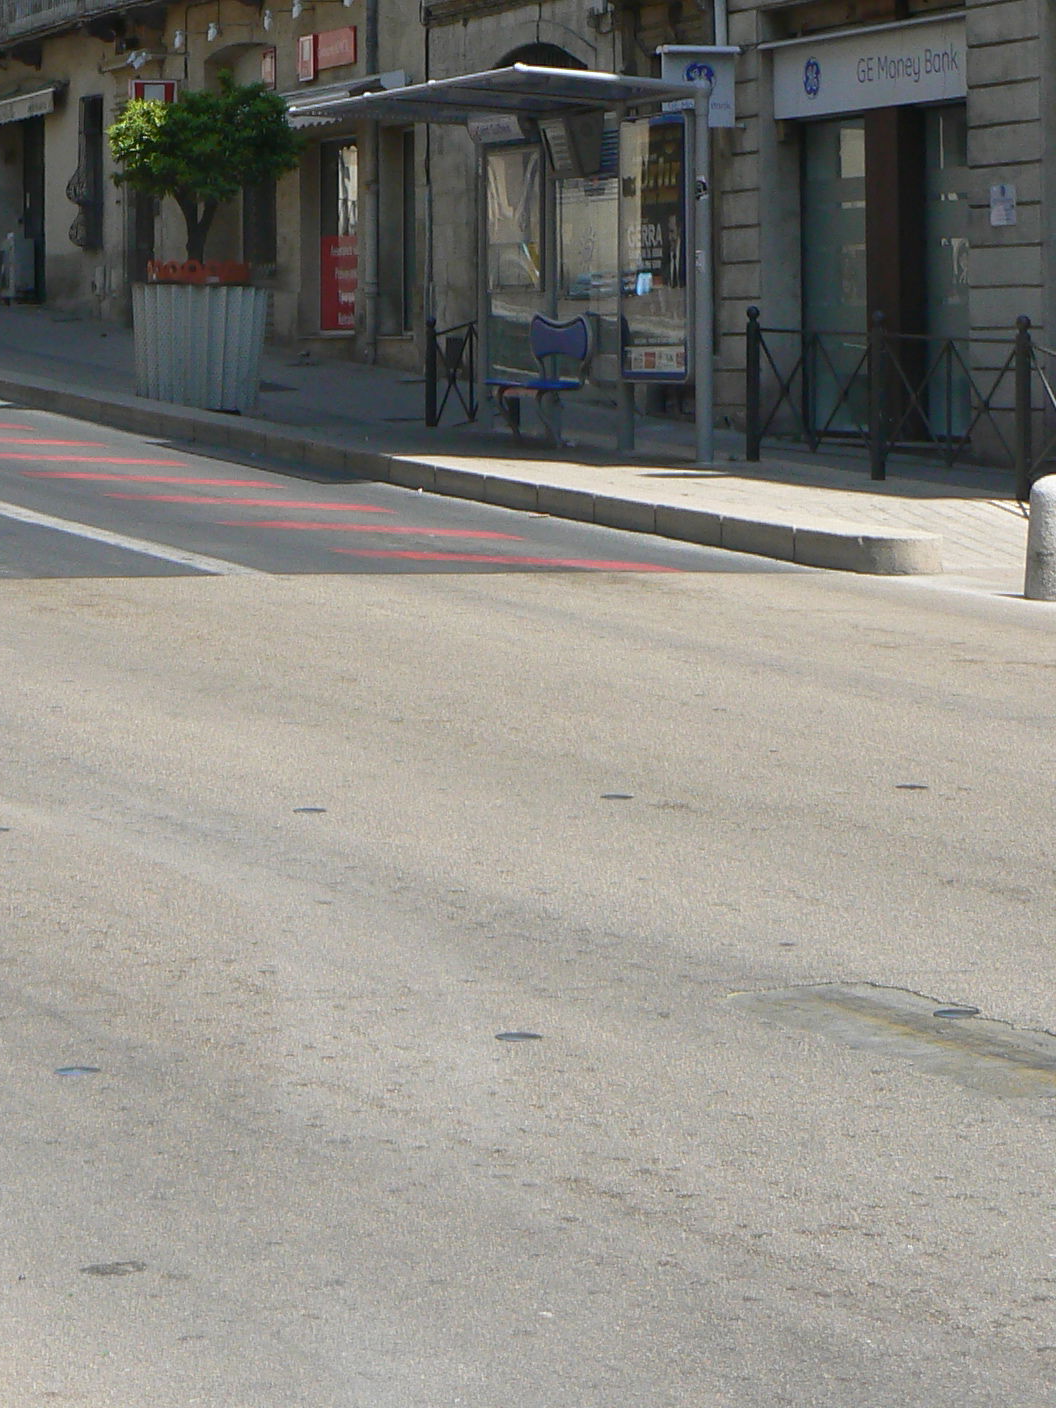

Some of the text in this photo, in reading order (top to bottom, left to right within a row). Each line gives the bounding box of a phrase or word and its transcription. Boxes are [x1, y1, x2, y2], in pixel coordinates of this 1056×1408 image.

[856, 44, 959, 83] GE Money Bank
[627, 223, 663, 248] GERRA
